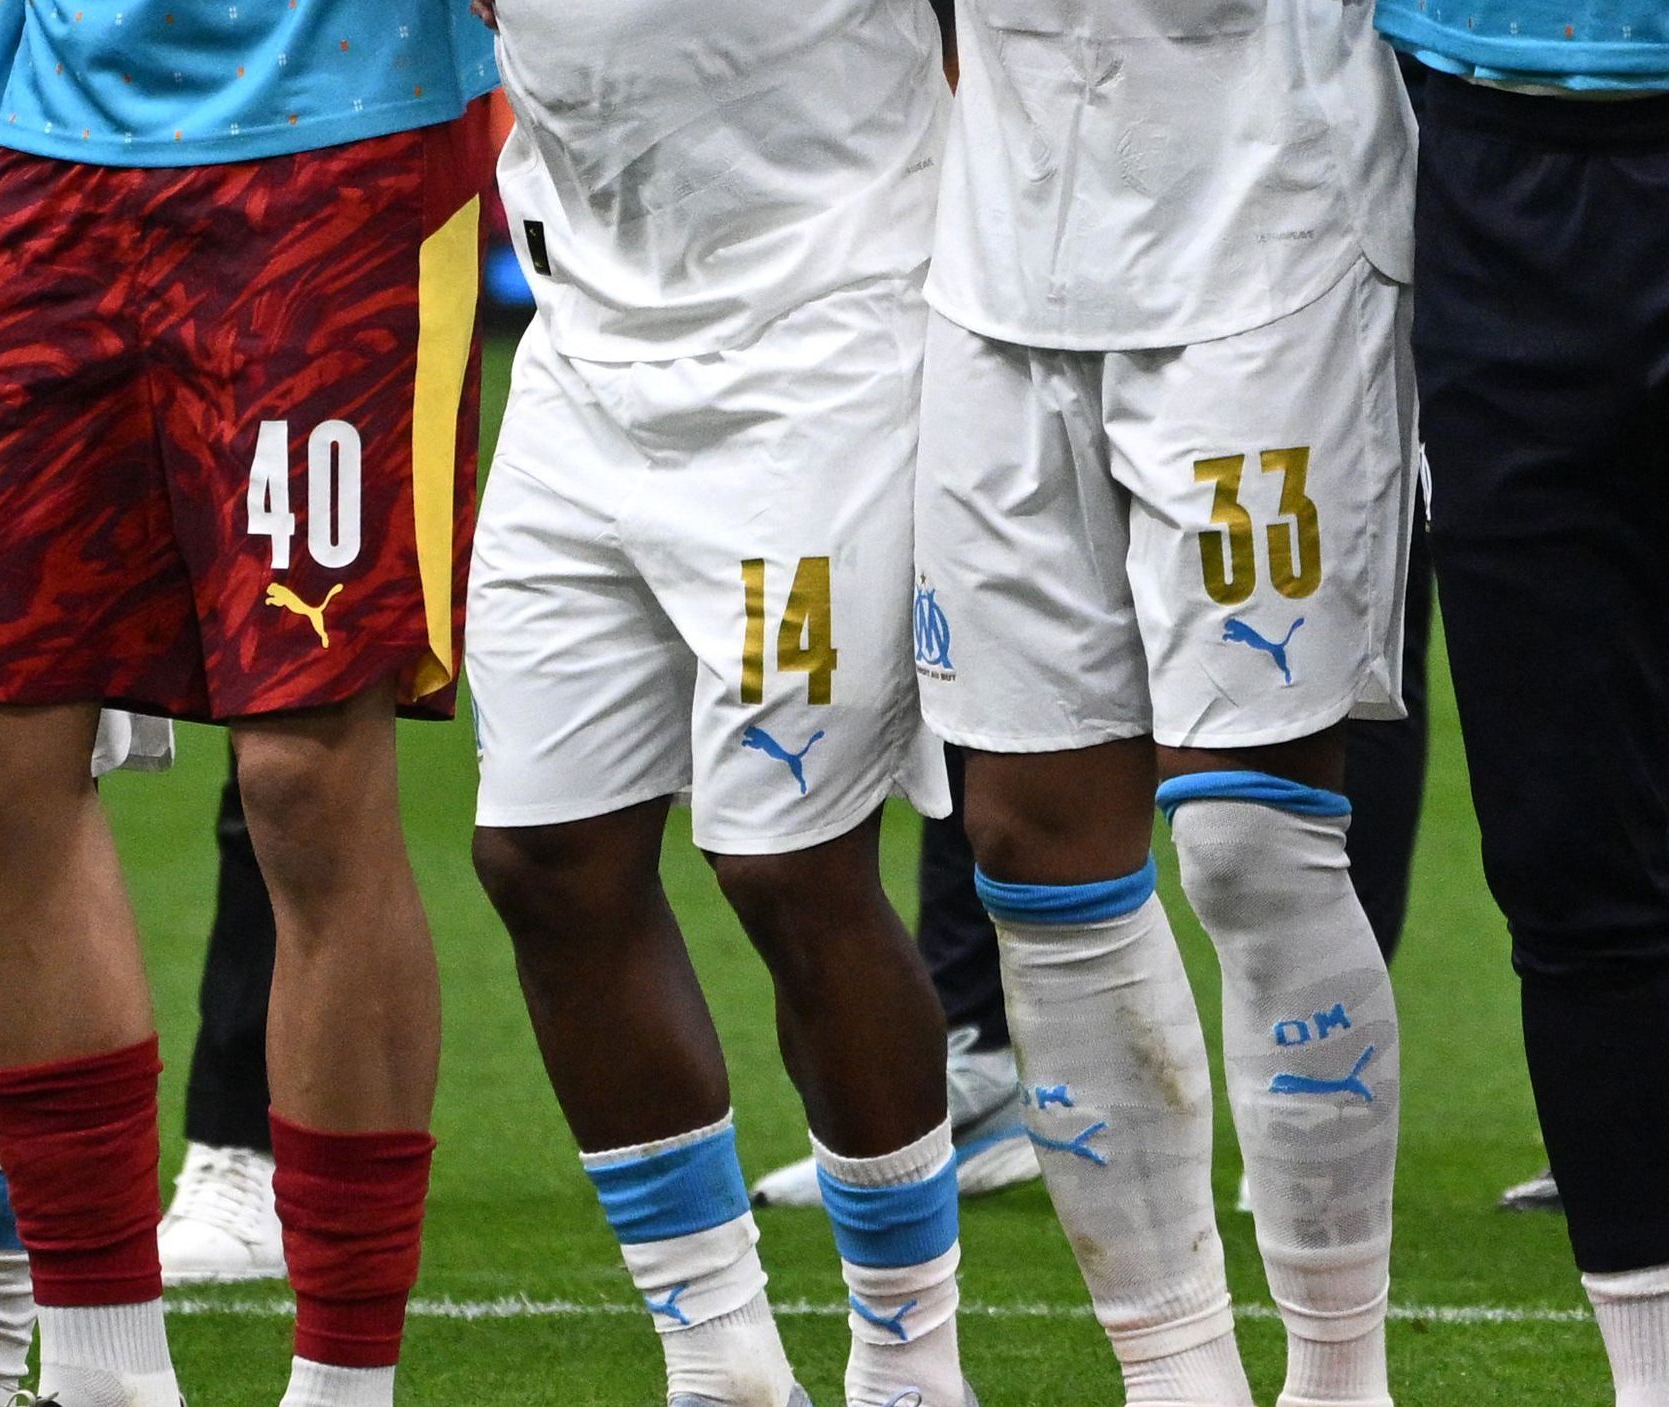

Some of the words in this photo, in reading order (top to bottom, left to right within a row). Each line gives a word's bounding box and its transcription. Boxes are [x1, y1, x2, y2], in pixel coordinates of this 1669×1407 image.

[247, 419, 362, 570] 40
[1193, 446, 1322, 607] 33
[739, 556, 837, 705] 14
[1273, 1002, 1351, 1046] OM
